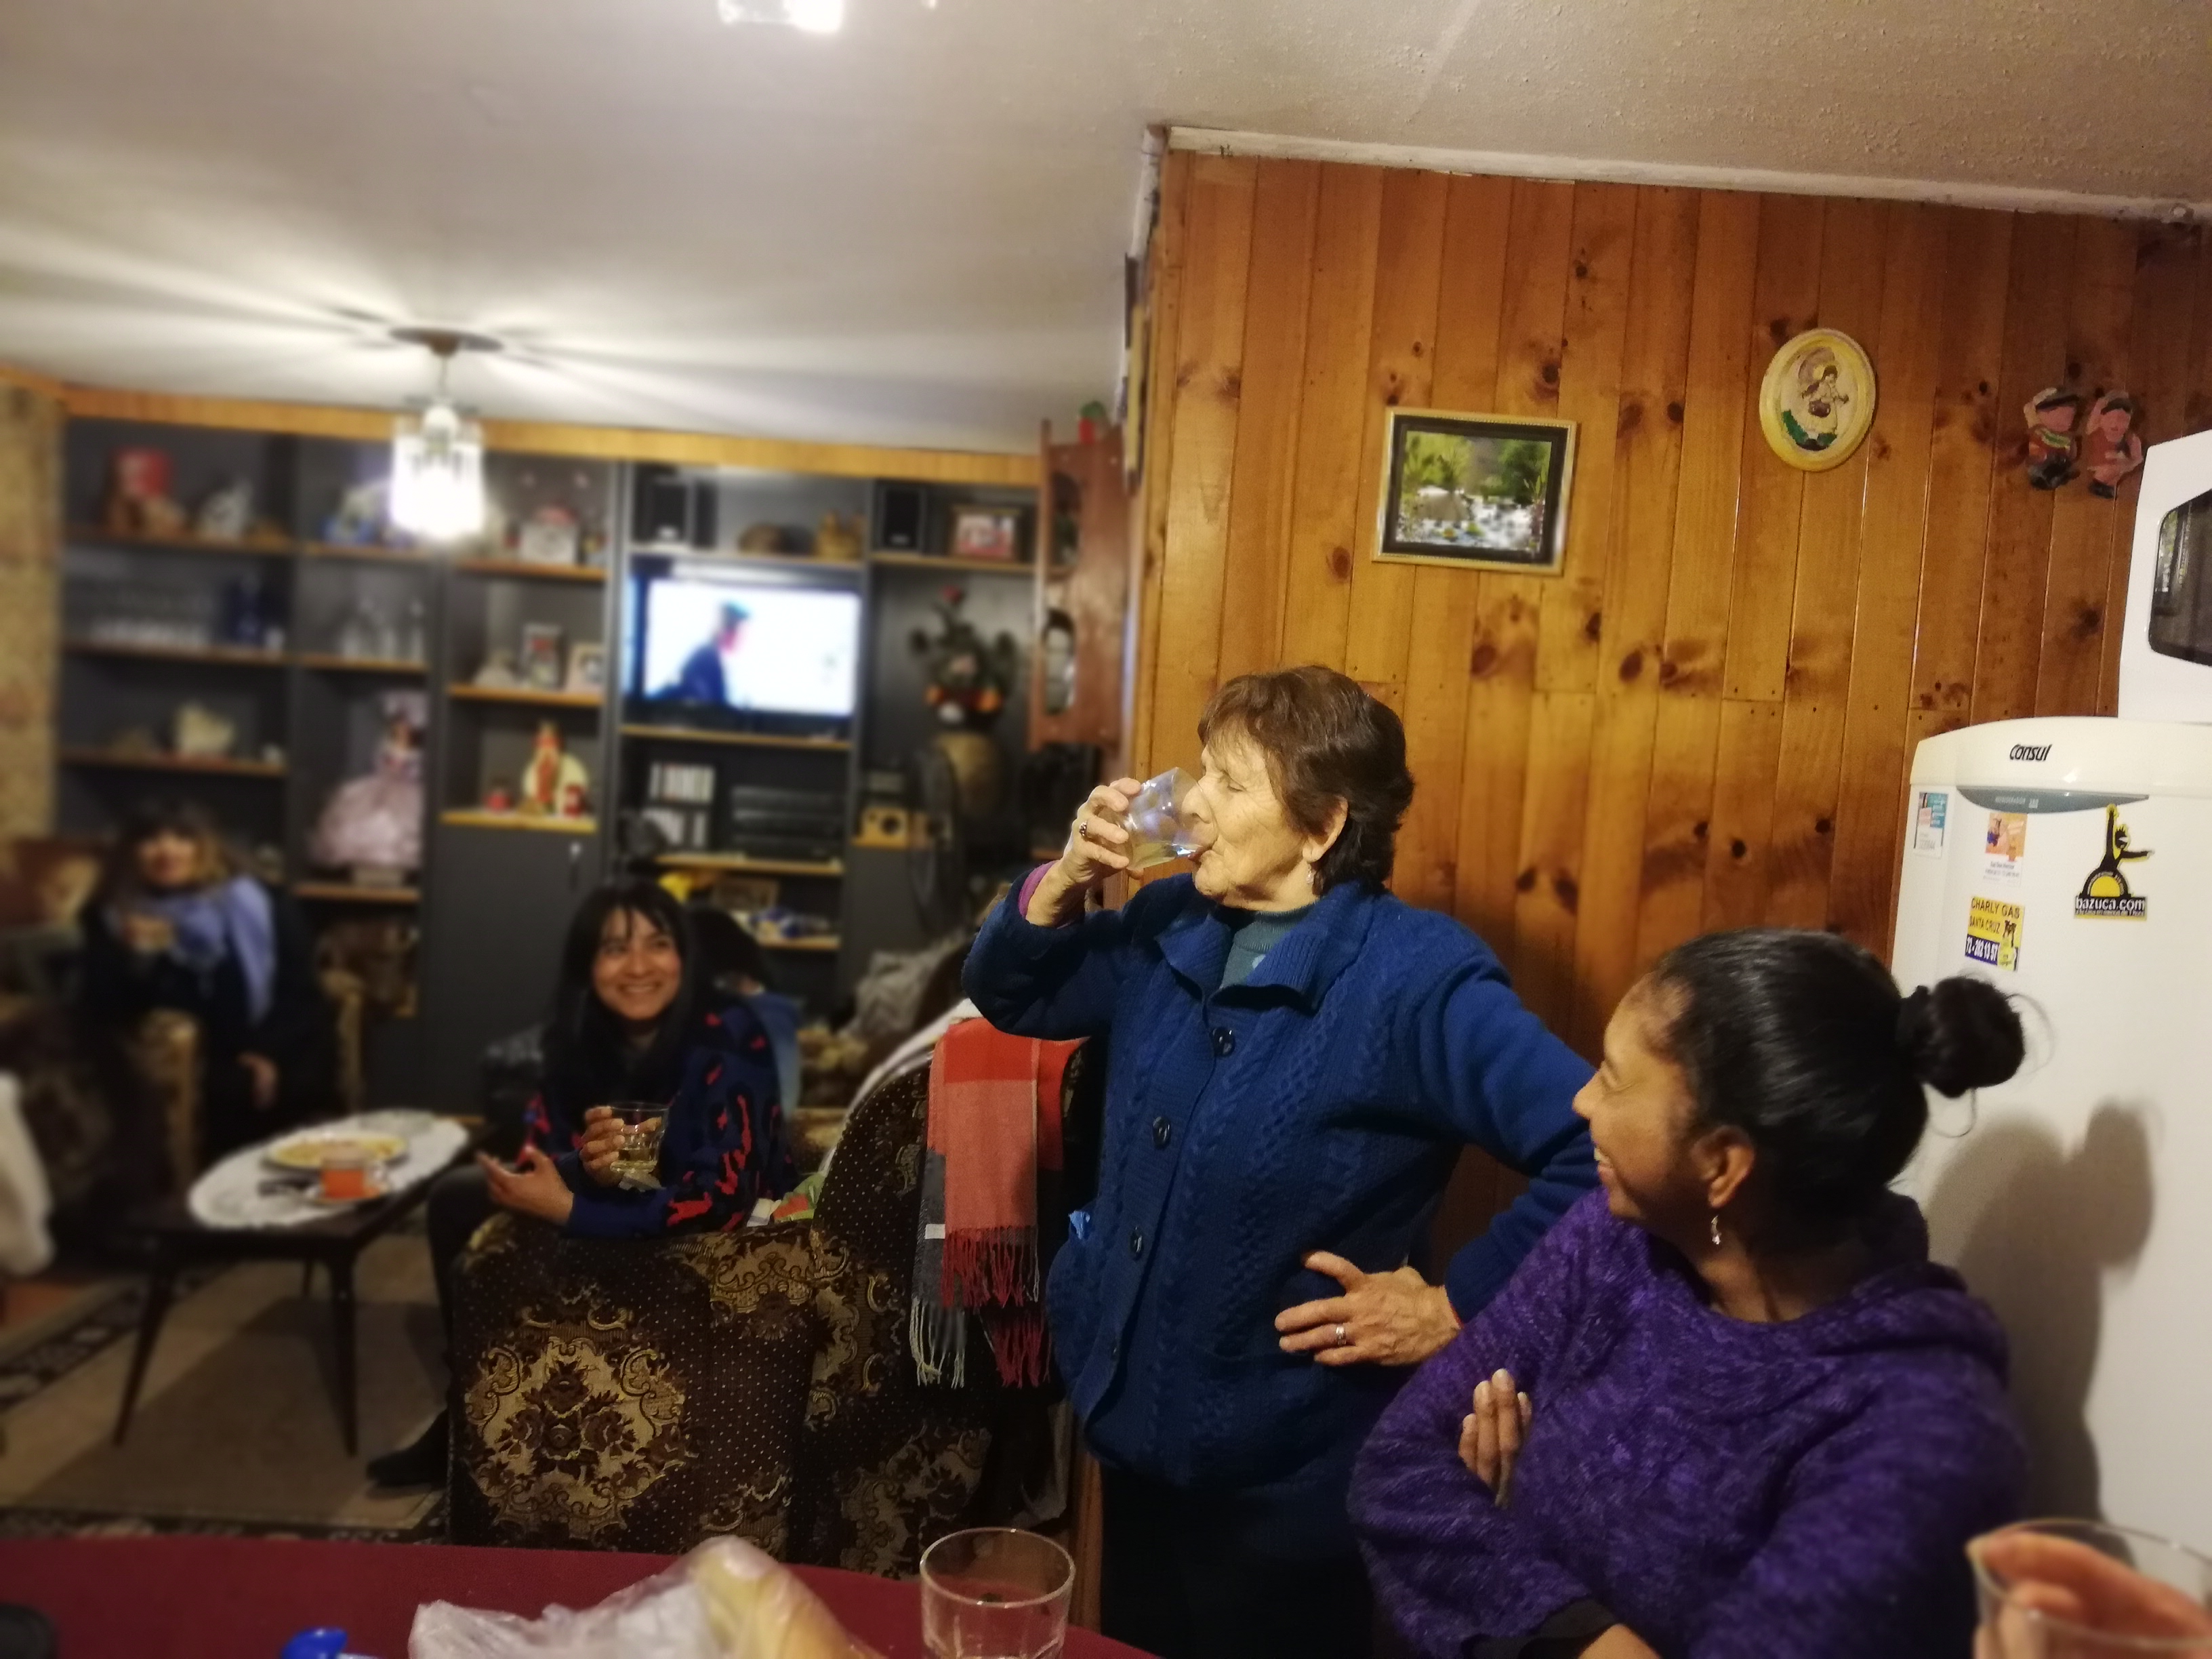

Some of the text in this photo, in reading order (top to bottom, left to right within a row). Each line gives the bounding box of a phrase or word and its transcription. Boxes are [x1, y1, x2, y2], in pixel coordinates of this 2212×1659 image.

[1971, 898, 1999, 915] CHARLY
[2076, 896, 2146, 911] bazuca.com
[1969, 916, 2001, 935] SANTA CRUZ
